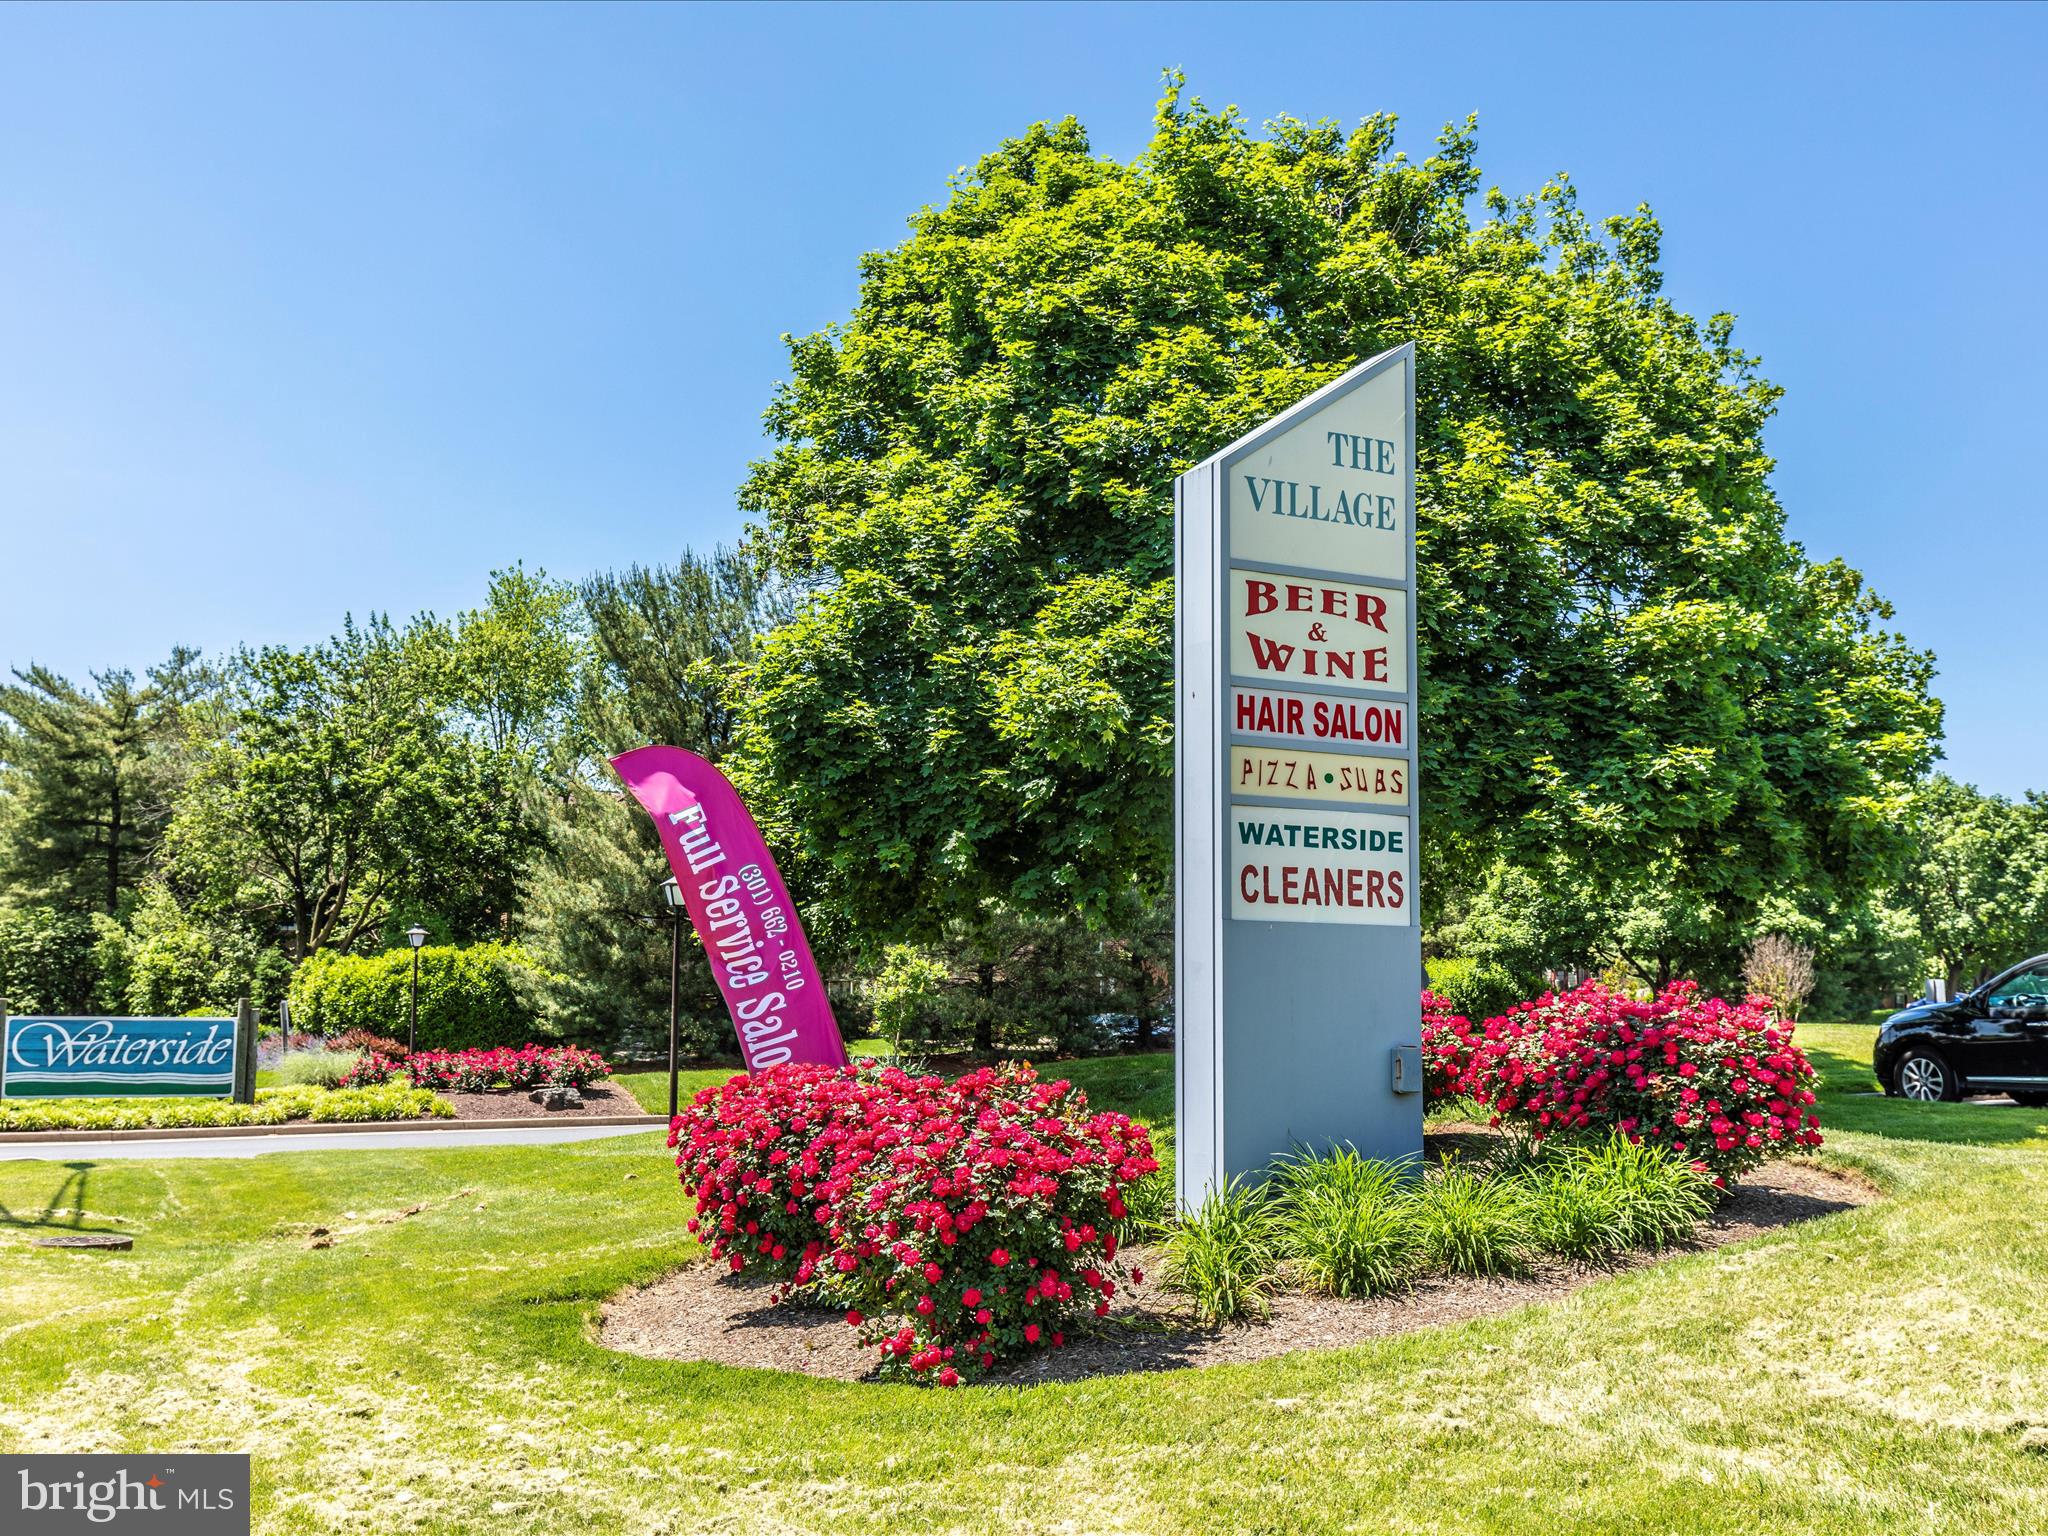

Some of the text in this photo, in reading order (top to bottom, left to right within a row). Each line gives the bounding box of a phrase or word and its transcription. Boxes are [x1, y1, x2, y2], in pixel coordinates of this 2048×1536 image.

[1327, 431, 1395, 475] THE
[1244, 475, 1396, 531] VILLAGE
[1245, 579, 1389, 634] BEER
[1307, 622, 1328, 642] &
[1246, 631, 1388, 683] WINE
[1237, 694, 1402, 744] HAIR SALON
[1240, 758, 1403, 794] PIZZA SUBS
[1238, 821, 1404, 854] WATERSIDE
[1240, 864, 1404, 909] CLEANERS
[668, 802, 798, 1069] Full Service Salo
[738, 864, 774, 906] (301)
[760, 906, 788, 939] 662
[778, 949, 805, 991] 0210
[11, 1020, 233, 1067] Waterside
